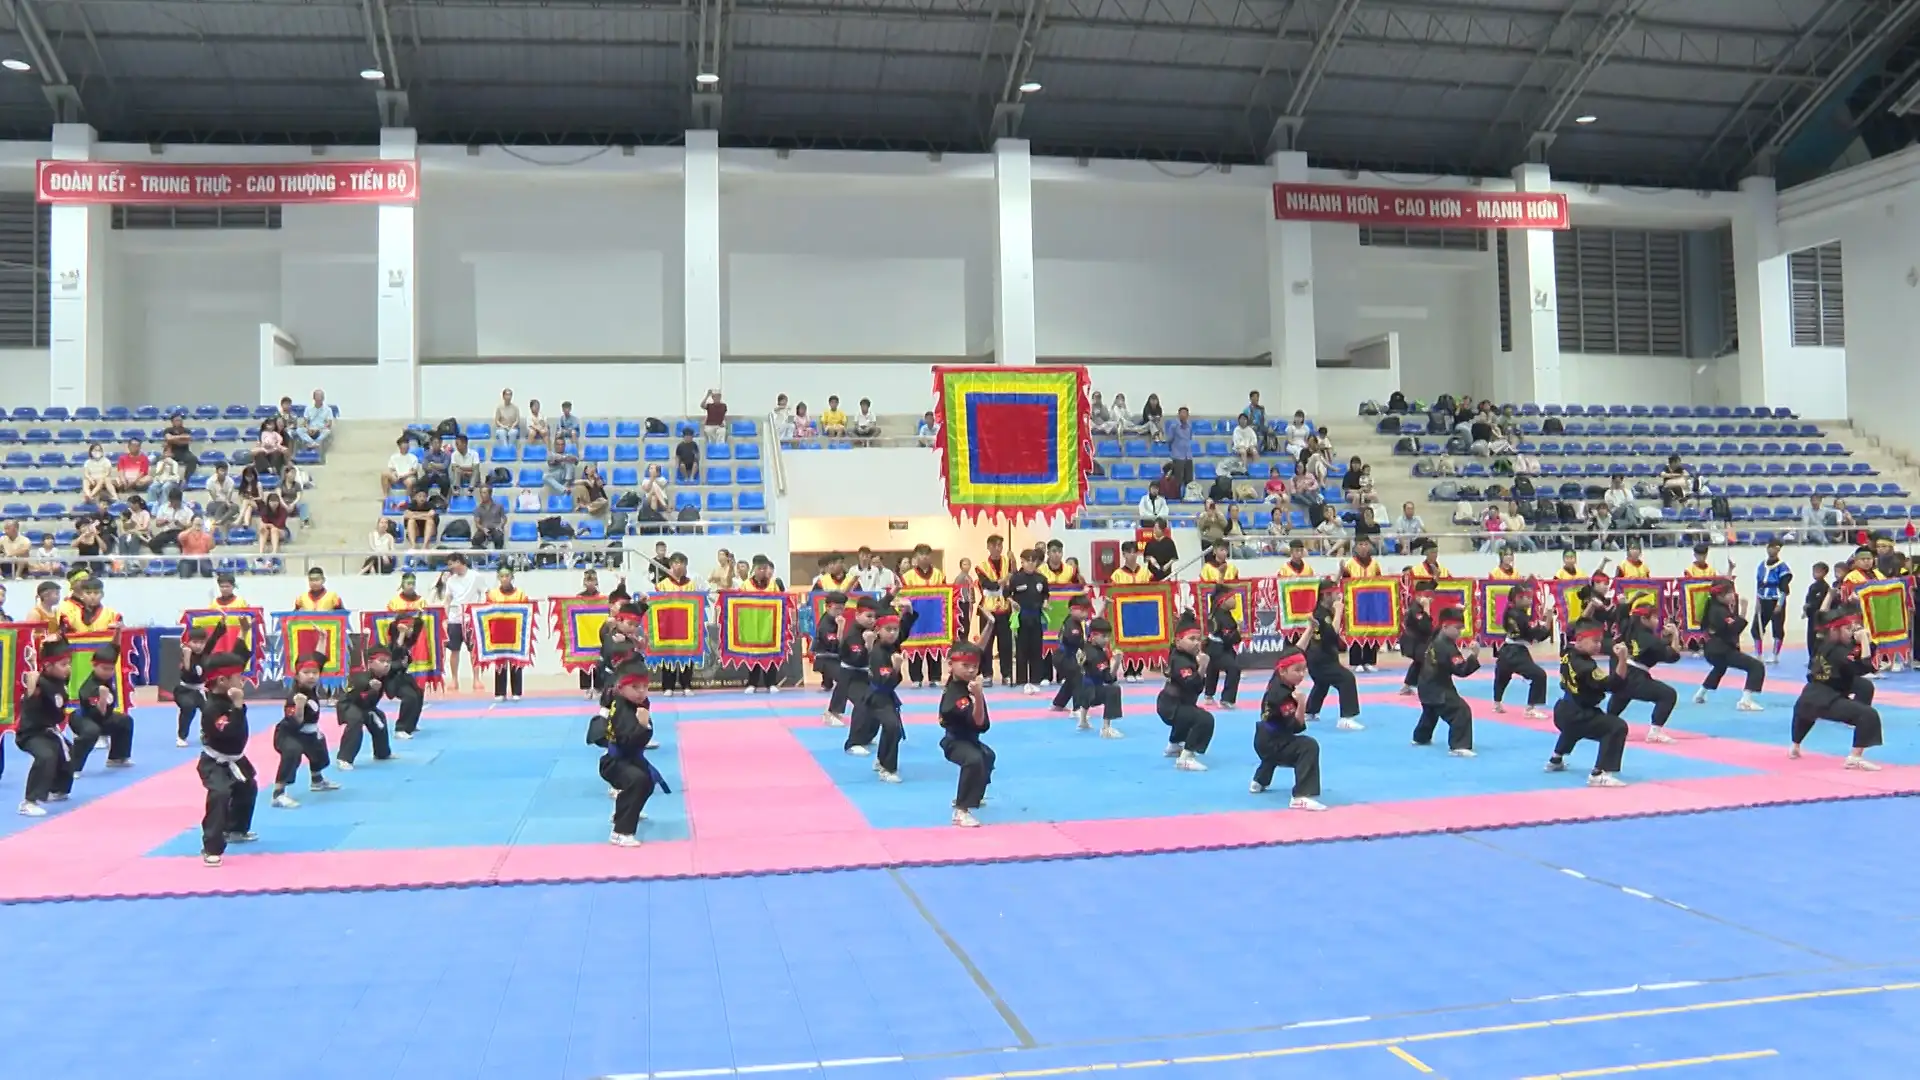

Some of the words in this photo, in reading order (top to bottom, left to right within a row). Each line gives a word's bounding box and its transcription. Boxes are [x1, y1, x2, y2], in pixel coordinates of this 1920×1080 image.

[50, 170, 92, 191] ĐOÀN
[98, 169, 126, 192] KẾT
[141, 175, 190, 193] TRUNG
[195, 173, 232, 197] THỰC
[246, 175, 275, 192] CAO
[280, 173, 336, 195] THƯỢNG
[350, 168, 383, 191] TIẾN
[387, 169, 406, 192] BỘ
[1286, 191, 1342, 212] NHANH
[1346, 194, 1379, 214] HƠN
[1394, 197, 1425, 216] CAO
[1430, 198, 1461, 217] HƠN
[1477, 200, 1522, 222] MẠNH
[1527, 199, 1558, 218] HƠN
